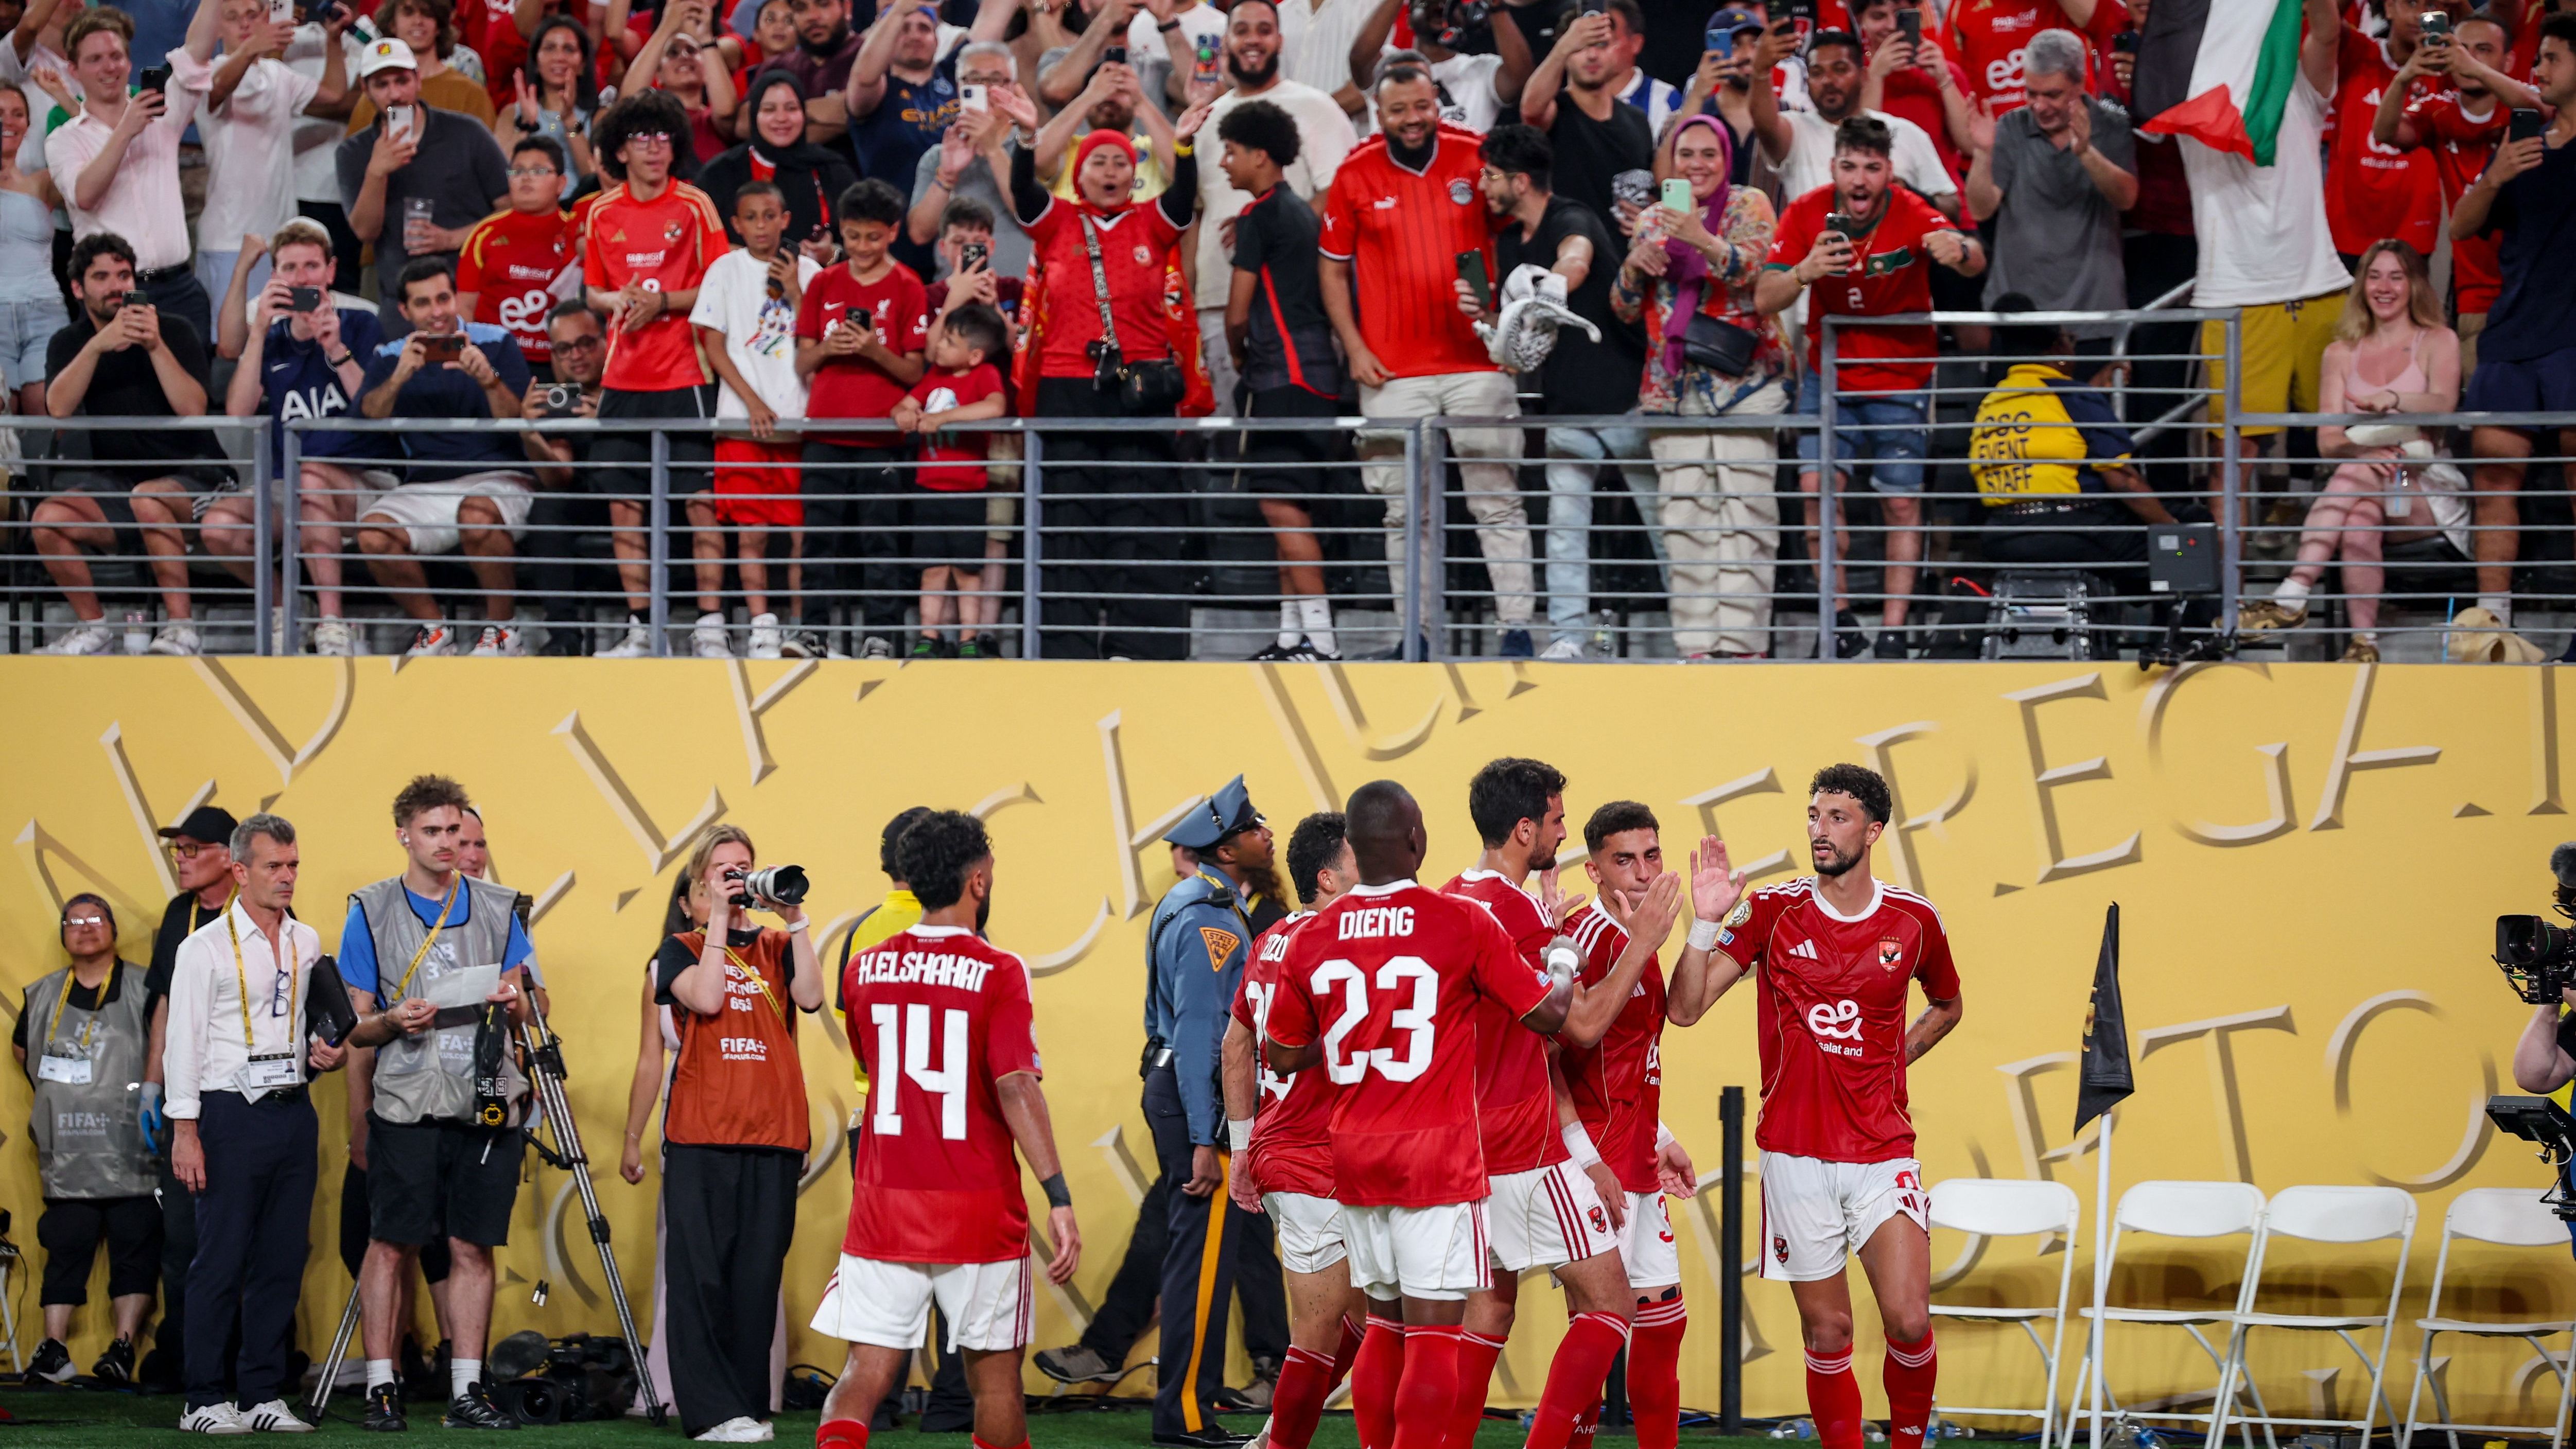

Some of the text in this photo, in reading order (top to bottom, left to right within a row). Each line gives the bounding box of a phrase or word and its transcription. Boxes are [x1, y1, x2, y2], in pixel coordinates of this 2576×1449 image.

[1847, 287, 1865, 309] 2
[281, 382, 349, 423] AIA
[1985, 463, 2033, 493] STAFF
[1338, 906, 1415, 941] DIENG
[858, 950, 993, 993] H.ELSHAHAT
[1310, 955, 1439, 1085] 23
[1844, 1045, 1863, 1057] and
[871, 1003, 969, 1141] 14
